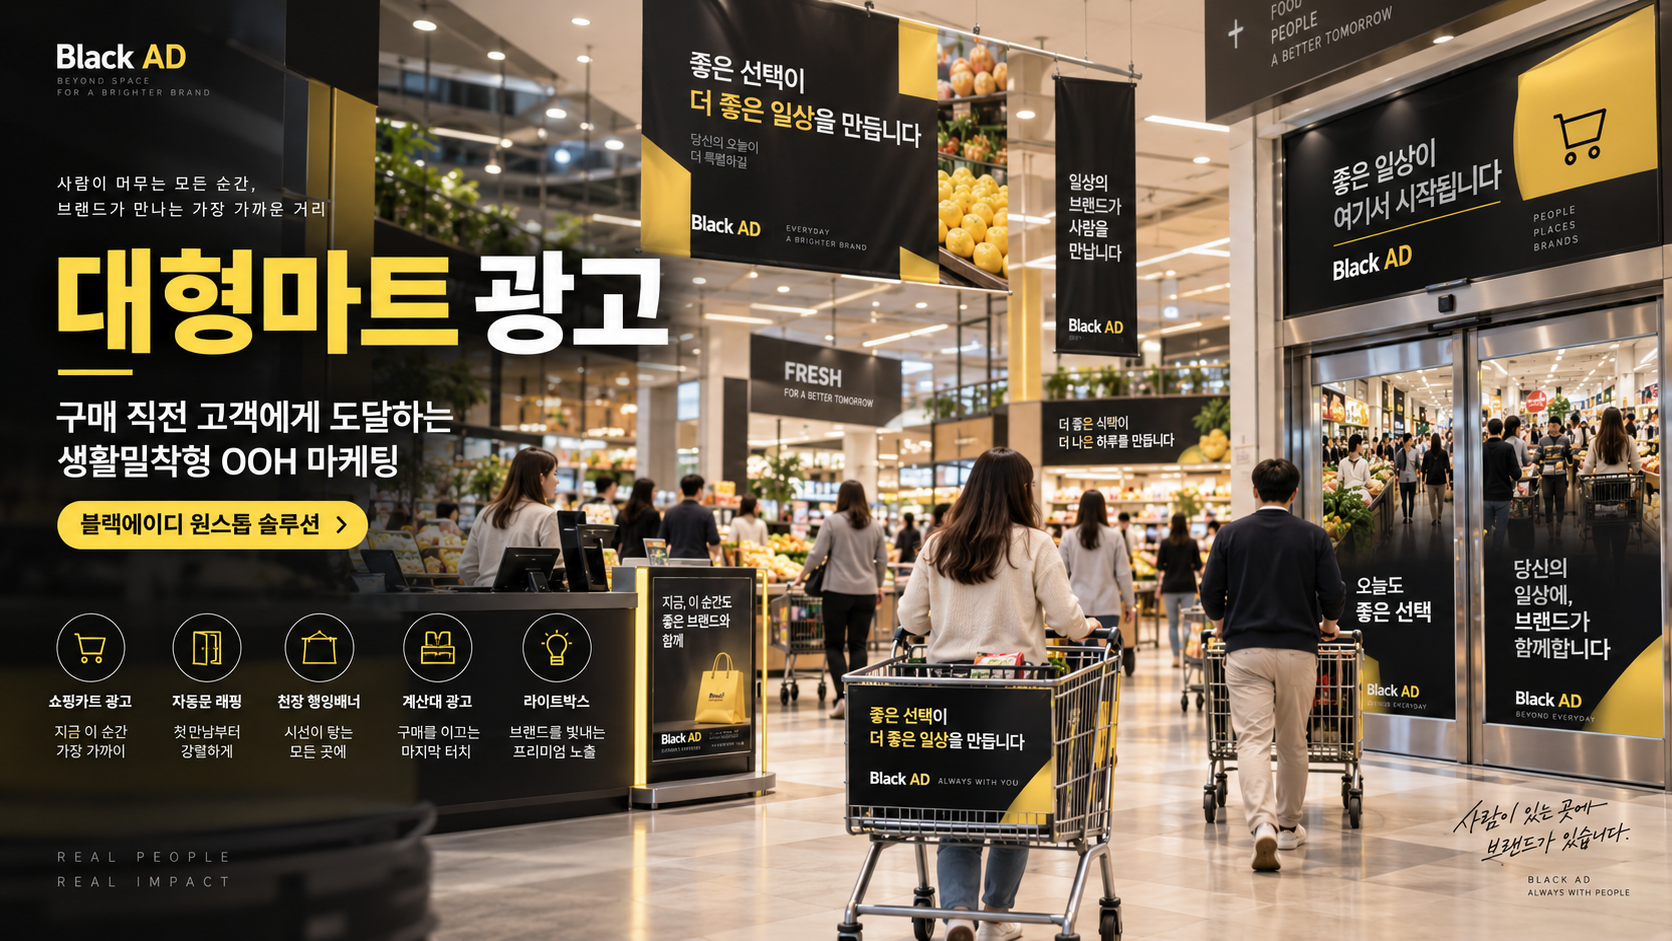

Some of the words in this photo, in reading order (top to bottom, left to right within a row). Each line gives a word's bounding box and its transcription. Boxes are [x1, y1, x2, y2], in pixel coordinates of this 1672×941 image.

[1271, 10, 1318, 44] PEOPLE
[1271, 53, 1278, 67] A
[1282, 36, 1322, 62] BETTER
[1325, 6, 1393, 44] TOMORROW
[689, 51, 734, 83] 좋은
[740, 59, 805, 94] 선택이
[691, 89, 712, 117] 더
[719, 92, 765, 124] 좋은
[771, 100, 836, 135] 일상을
[842, 111, 922, 149] 만듭니다
[690, 133, 724, 149] 당신의
[726, 138, 759, 155] 오늘이
[690, 150, 702, 163] 더
[1332, 160, 1370, 196] 좋은
[1375, 138, 1436, 184] 일상이
[1069, 173, 1108, 192] 일상의
[1333, 191, 1390, 232] 여기서
[1396, 159, 1502, 213] 시작됩니다
[1069, 196, 1122, 216] 브랜드가
[1533, 205, 1576, 223] PEOPLE
[691, 213, 734, 235] Black
[737, 220, 761, 237] AD
[786, 224, 830, 236] EVERYDAY
[1069, 219, 1108, 238] 사람을
[1533, 220, 1576, 237] PLACES
[794, 236, 836, 248] BRIGHTER
[838, 242, 867, 251] BRAND
[1069, 242, 1122, 262] 만납니다
[1533, 235, 1579, 252] BRANDS
[1333, 252, 1380, 281] Black
[1384, 244, 1412, 271] AD
[1068, 317, 1102, 334] Black
[1104, 320, 1124, 334] AD
[785, 361, 842, 388] FRESH
[784, 388, 799, 398] FOR
[800, 391, 806, 399] A
[808, 392, 833, 403] BETTER
[834, 394, 874, 408] TOMORROW
[1059, 417, 1069, 431] 더
[1059, 435, 1069, 449] 더
[1072, 435, 1093, 449] 나은
[1131, 432, 1175, 448] 만듭니다
[1514, 557, 1567, 579] 당신의
[1356, 577, 1404, 595] 오늘도
[1514, 584, 1573, 607] 일상에,
[662, 595, 686, 611] 지금,
[688, 595, 699, 610] 이
[700, 595, 733, 609] 순간도
[1356, 602, 1391, 623] 좋은
[1395, 601, 1432, 624] 선택
[662, 614, 684, 629] 좋은
[686, 613, 731, 629] 브랜드와
[1514, 611, 1591, 633] 브랜드가
[662, 633, 684, 649] 함께
[1514, 637, 1611, 661] 함께합니다
[1367, 683, 1398, 697] Black
[1401, 685, 1420, 698] AD
[1515, 690, 1555, 707] Black
[1558, 693, 1583, 708] AD
[869, 706, 899, 724] 좋은
[902, 707, 948, 726] 선택이
[1515, 710, 1549, 719] BEYOND
[1552, 713, 1596, 722] EVERYDAY
[661, 733, 686, 745] Black
[687, 731, 702, 743] AD
[869, 730, 885, 748] 더
[887, 730, 917, 748] 좋은
[919, 731, 963, 750] 일상을
[966, 733, 1025, 752] 만듭니다
[869, 771, 907, 787] Black
[909, 773, 930, 787] AD
[937, 777, 972, 785] ALWAYS
[975, 777, 997, 785] WITH
[1000, 777, 1019, 786] YOU
